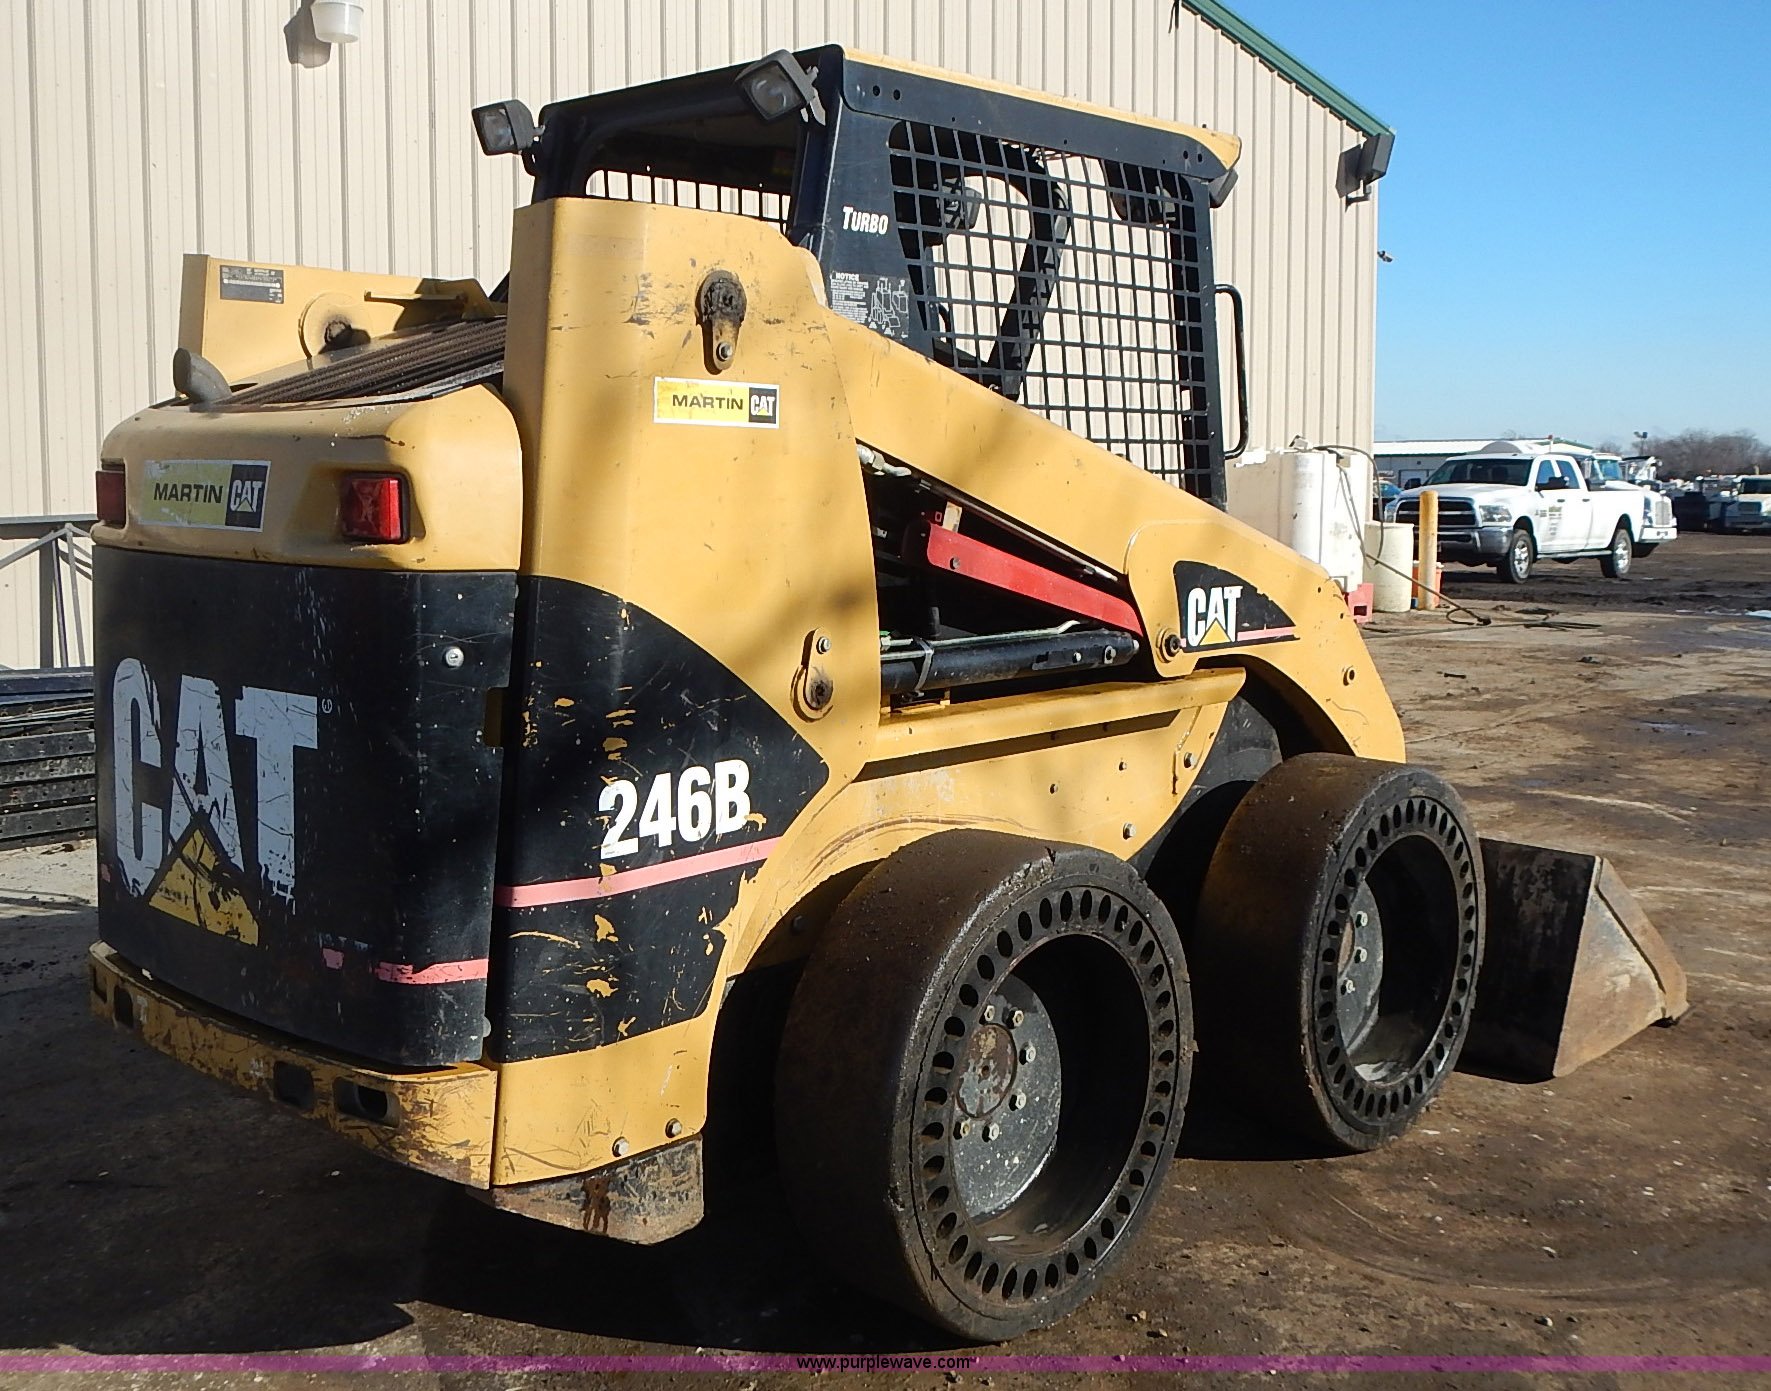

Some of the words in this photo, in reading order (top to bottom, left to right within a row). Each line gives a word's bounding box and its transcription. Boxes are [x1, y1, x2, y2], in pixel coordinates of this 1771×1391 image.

[672, 394, 744, 410] MARTIN
[750, 394, 776, 417] CAT
[153, 482, 224, 504] MARTIN
[230, 479, 264, 513] CAT
[1187, 585, 1244, 647] CAT
[112, 657, 319, 902] CAT
[598, 759, 751, 860] 246B
